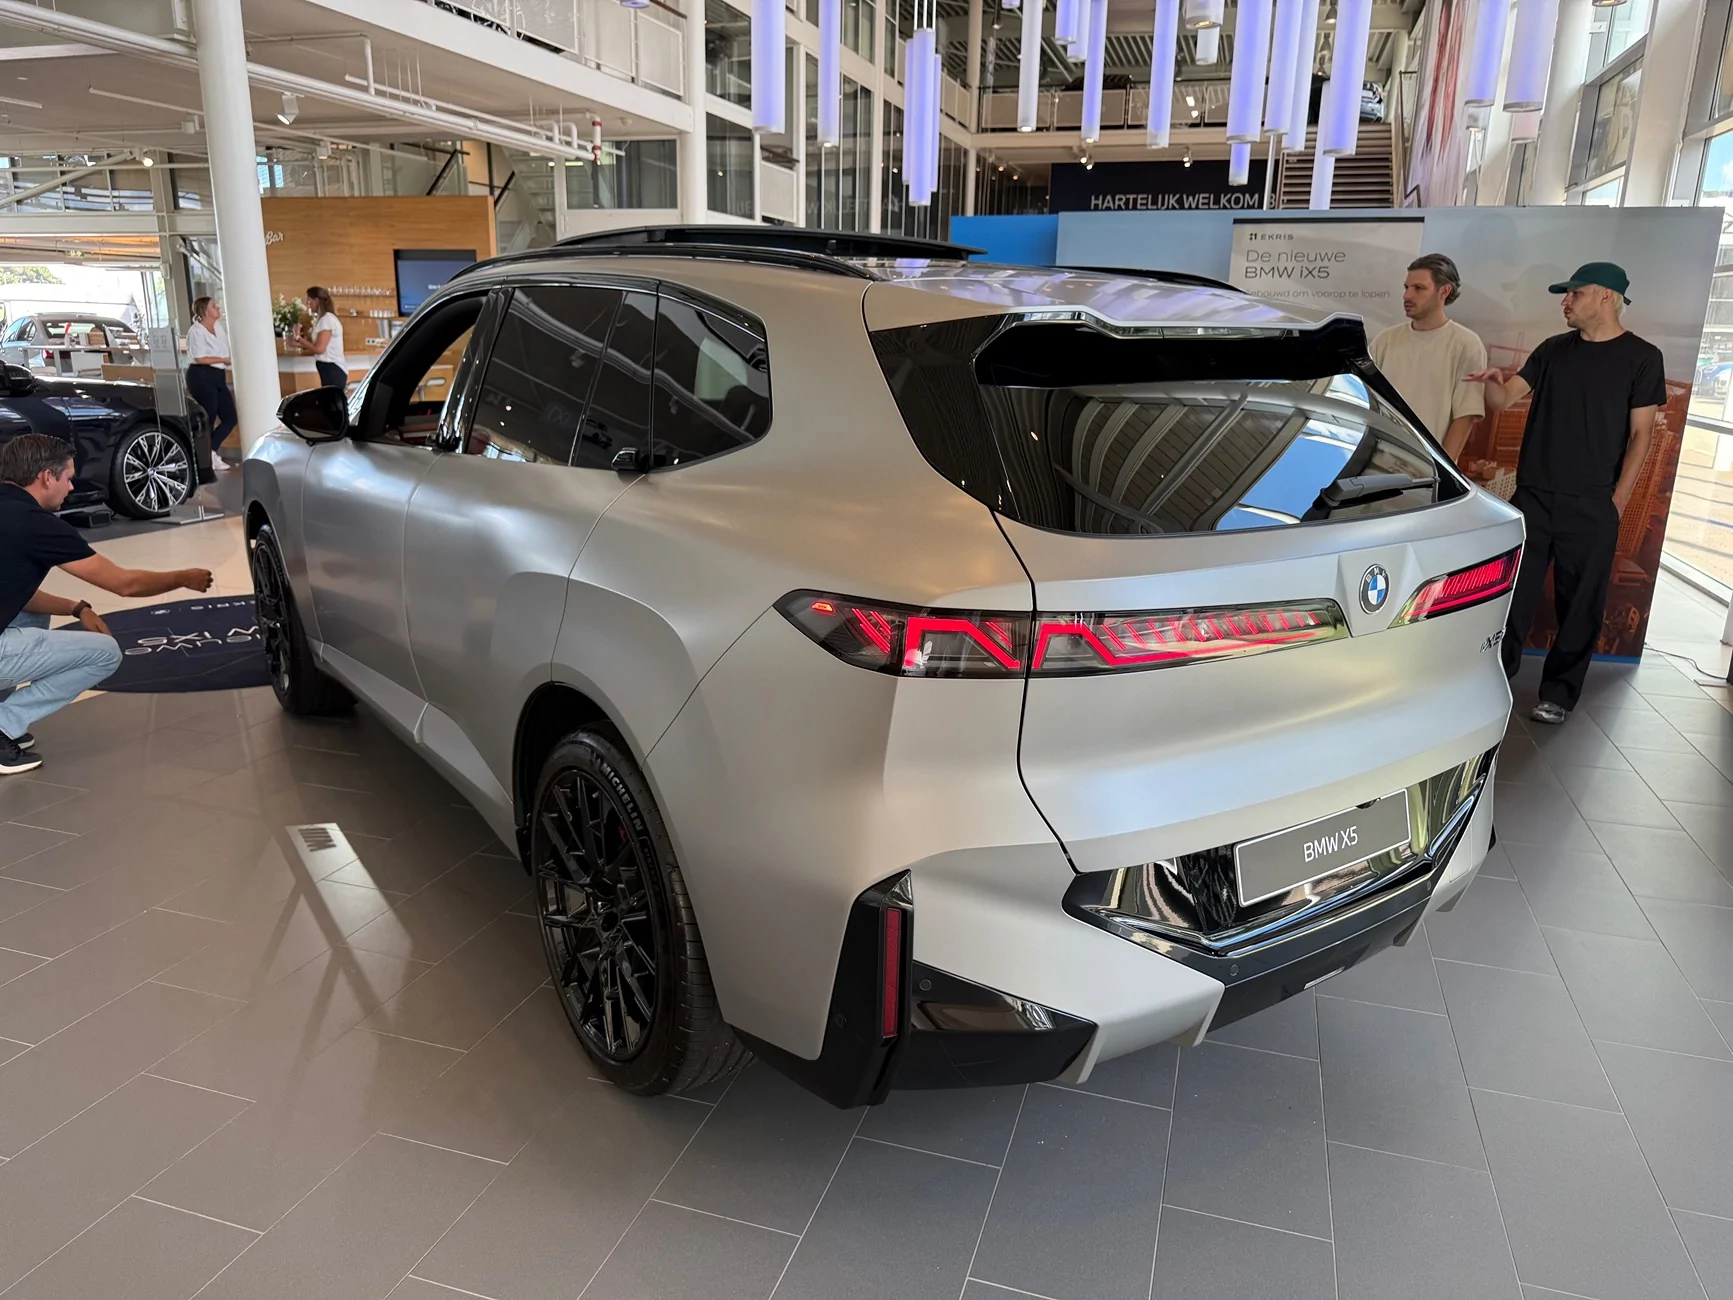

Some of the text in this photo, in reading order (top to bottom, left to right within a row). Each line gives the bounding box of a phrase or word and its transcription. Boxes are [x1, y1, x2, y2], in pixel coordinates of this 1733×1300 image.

[1090, 194, 1180, 210] HARTELIJK
[1182, 193, 1259, 209] WELKOM
[265, 230, 284, 246] Bar
[1260, 233, 1294, 241] EKRIS
[1246, 249, 1346, 263] De nieuwe
[1244, 265, 1330, 279] BMW iX5
[1292, 290, 1309, 298] om
[1311, 290, 1346, 299] voorop
[1348, 289, 1359, 298] te
[1361, 288, 1390, 299] lopen
[1365, 566, 1387, 583] BMW
[600, 762, 644, 832] MICHELIN
[1303, 825, 1358, 863] BMW X5
